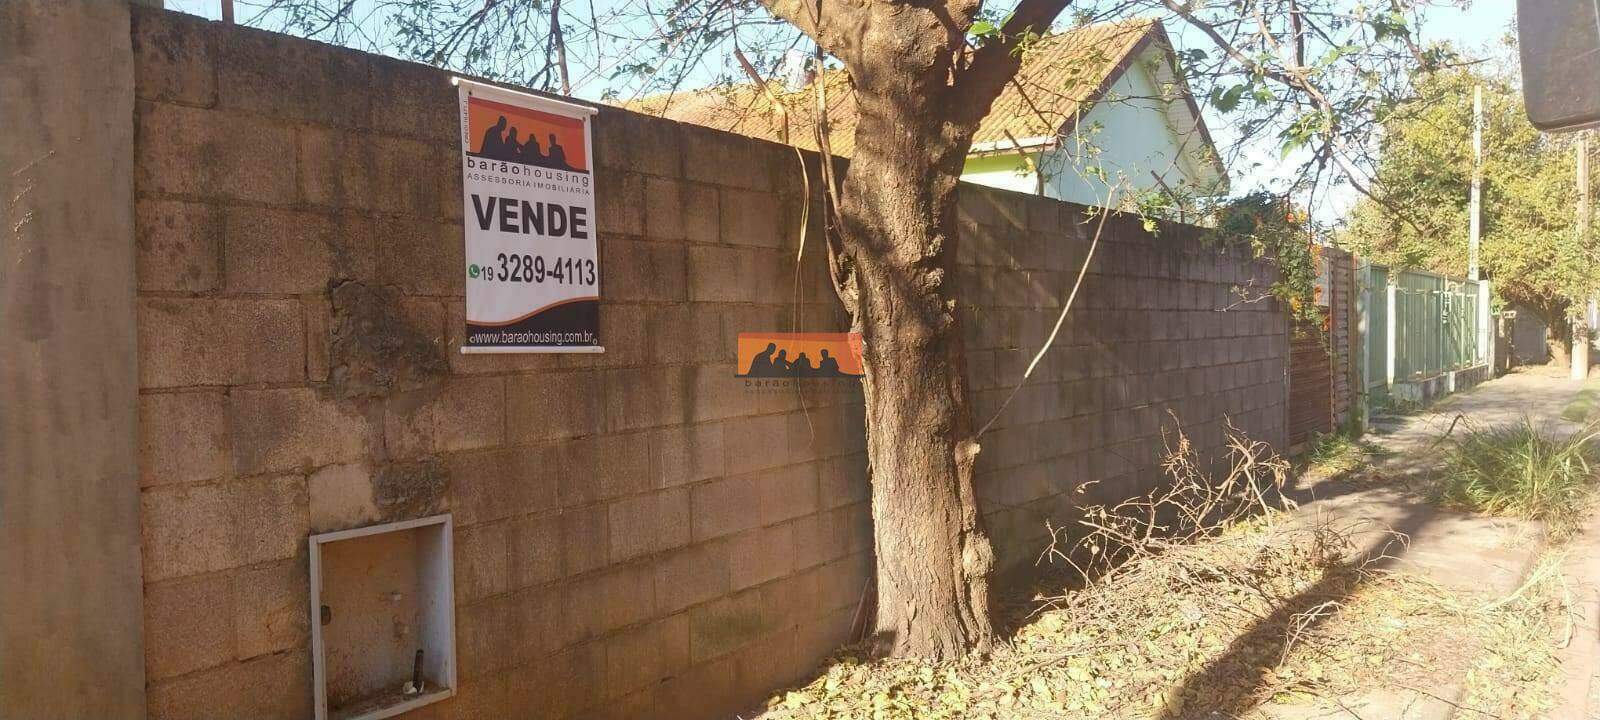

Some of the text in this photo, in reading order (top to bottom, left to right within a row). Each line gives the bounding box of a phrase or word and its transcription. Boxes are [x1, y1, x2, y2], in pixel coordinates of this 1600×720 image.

[467, 157, 589, 187] barãohousing
[467, 173, 531, 188] ASSESSORIA
[471, 194, 588, 240] VENDE
[481, 252, 596, 286] 19 3289-4113
[474, 329, 593, 346] www.baraohousing.com.br
